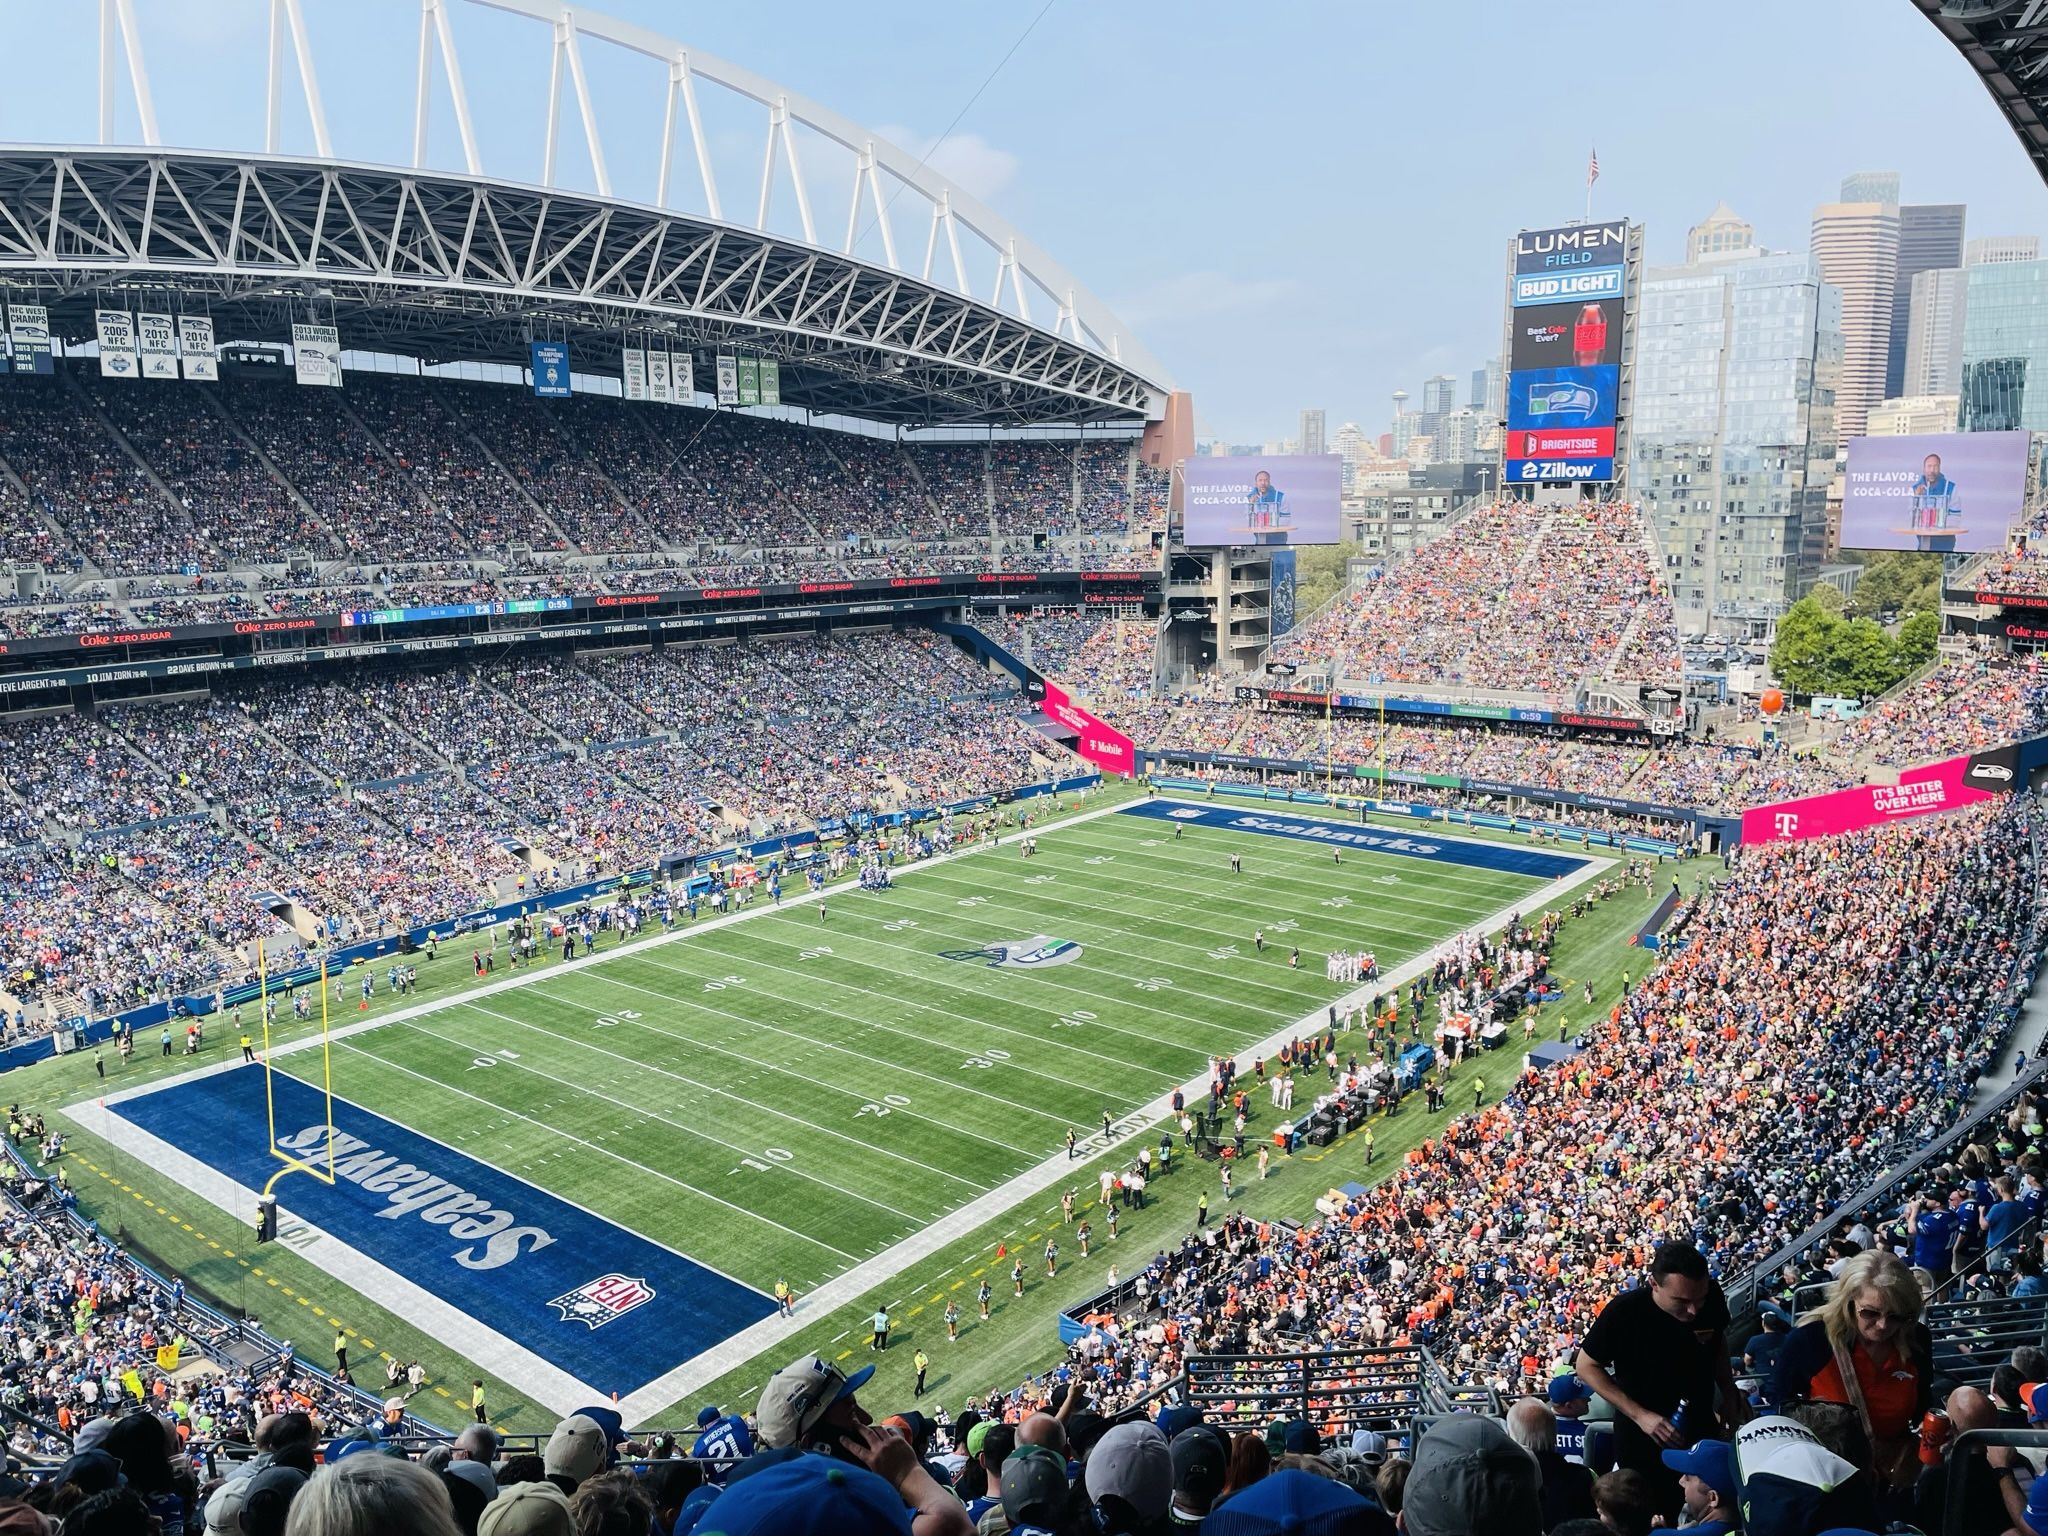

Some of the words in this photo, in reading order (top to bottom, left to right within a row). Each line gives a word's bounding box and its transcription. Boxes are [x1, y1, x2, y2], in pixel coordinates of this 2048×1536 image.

[1518, 226, 1624, 254] LUMEN
[1546, 252, 1592, 266] FIELD
[1521, 280, 1559, 297] BUD
[1561, 274, 1617, 293] LIGHT
[10, 306, 24, 314] NFC
[26, 307, 46, 315] WEST
[10, 315, 47, 324] CHAMPS
[103, 326, 128, 337] 2005
[145, 329, 169, 340] 2013
[185, 331, 209, 342] 2014
[294, 325, 312, 334] 2013
[313, 326, 336, 336] WORLD
[1527, 328, 1548, 336] Best
[107, 337, 126, 346] NFC
[149, 340, 167, 348] NFC
[294, 334, 337, 344] CHAMPIONS
[1535, 334, 1560, 343] Ever?
[100, 345, 136, 353] CHAMPIONS
[141, 348, 176, 356] CHAMPIONS
[189, 342, 207, 350] NFC
[182, 350, 216, 358] CHAMPIONS
[1541, 438, 1598, 450] BRIGHTSIDE
[1539, 462, 1594, 478] Zillow
[1852, 473, 1871, 482] THE
[1873, 471, 1919, 482] FLAVOR:
[1191, 485, 1208, 493] THE
[1853, 487, 1915, 497] COCA-COLA
[1193, 496, 1250, 505] COCA-COLA
[976, 574, 997, 582] Coke
[1081, 572, 1100, 581] Coke
[800, 584, 818, 592] Coke
[891, 579, 907, 587] Coke
[703, 589, 722, 599] Coke
[740, 588, 761, 596] SUGAR
[1085, 594, 1104, 602] Coke
[1976, 592, 2000, 604] Coke
[2026, 598, 2048, 607] SUGA
[548, 600, 568, 609] 0:59
[596, 596, 618, 606] Coke
[637, 595, 660, 603] SUGAR
[495, 604, 504, 613] 25
[361, 613, 367, 624] 3
[234, 622, 262, 634] Coke
[263, 622, 287, 631] ZERO
[287, 619, 316, 629] SUGAR
[2006, 624, 2031, 637] Coke
[80, 634, 111, 647] Coke
[113, 634, 139, 643] ZERO
[140, 631, 172, 642] SUGAR
[548, 629, 565, 638] KENNY
[564, 628, 581, 637] EASLEY
[431, 640, 448, 649] ALLEN
[324, 650, 335, 659] 28
[334, 649, 350, 658] CURT
[350, 647, 374, 657] WARNER
[257, 655, 273, 666] PETE
[273, 654, 294, 664] GROSS
[167, 665, 179, 675] 22
[178, 663, 195, 674] DAVE
[196, 661, 220, 672] BROWN
[86, 673, 99, 683] 10
[98, 671, 113, 682] JIM
[113, 670, 132, 681] ZORN
[0, 681, 17, 693] TEVE
[17, 678, 50, 690] LARGENT
[1268, 691, 1288, 700] Coke
[1520, 711, 1542, 721] 0:59
[1561, 714, 1585, 725] Coke
[1587, 718, 1609, 726] ZERO
[1609, 720, 1638, 729] SUGAR
[1655, 721, 1672, 733] 25
[1098, 741, 1123, 756] Mobile
[1388, 771, 1427, 783] Seahawks
[1872, 787, 1895, 801] IT'S
[1897, 780, 1943, 797] BETTER
[1874, 797, 1909, 811] OVER
[1912, 791, 1946, 805] HERE
[1376, 801, 1412, 814] Seahawks
[1775, 813, 1798, 838] T
[1229, 816, 1443, 855] Seahawks
[1133, 976, 1174, 992] 50
[595, 1008, 643, 1027] 20
[1060, 1009, 1099, 1028] 40
[472, 1049, 521, 1068] 10
[965, 1048, 1012, 1069] 30
[859, 1093, 912, 1118] 20
[740, 1147, 795, 1173] 10
[276, 1125, 558, 1270] Seahawks
[586, 1275, 647, 1311] NFL
[703, 1423, 733, 1446] WITHERSPOON
[707, 1433, 743, 1474] 21
